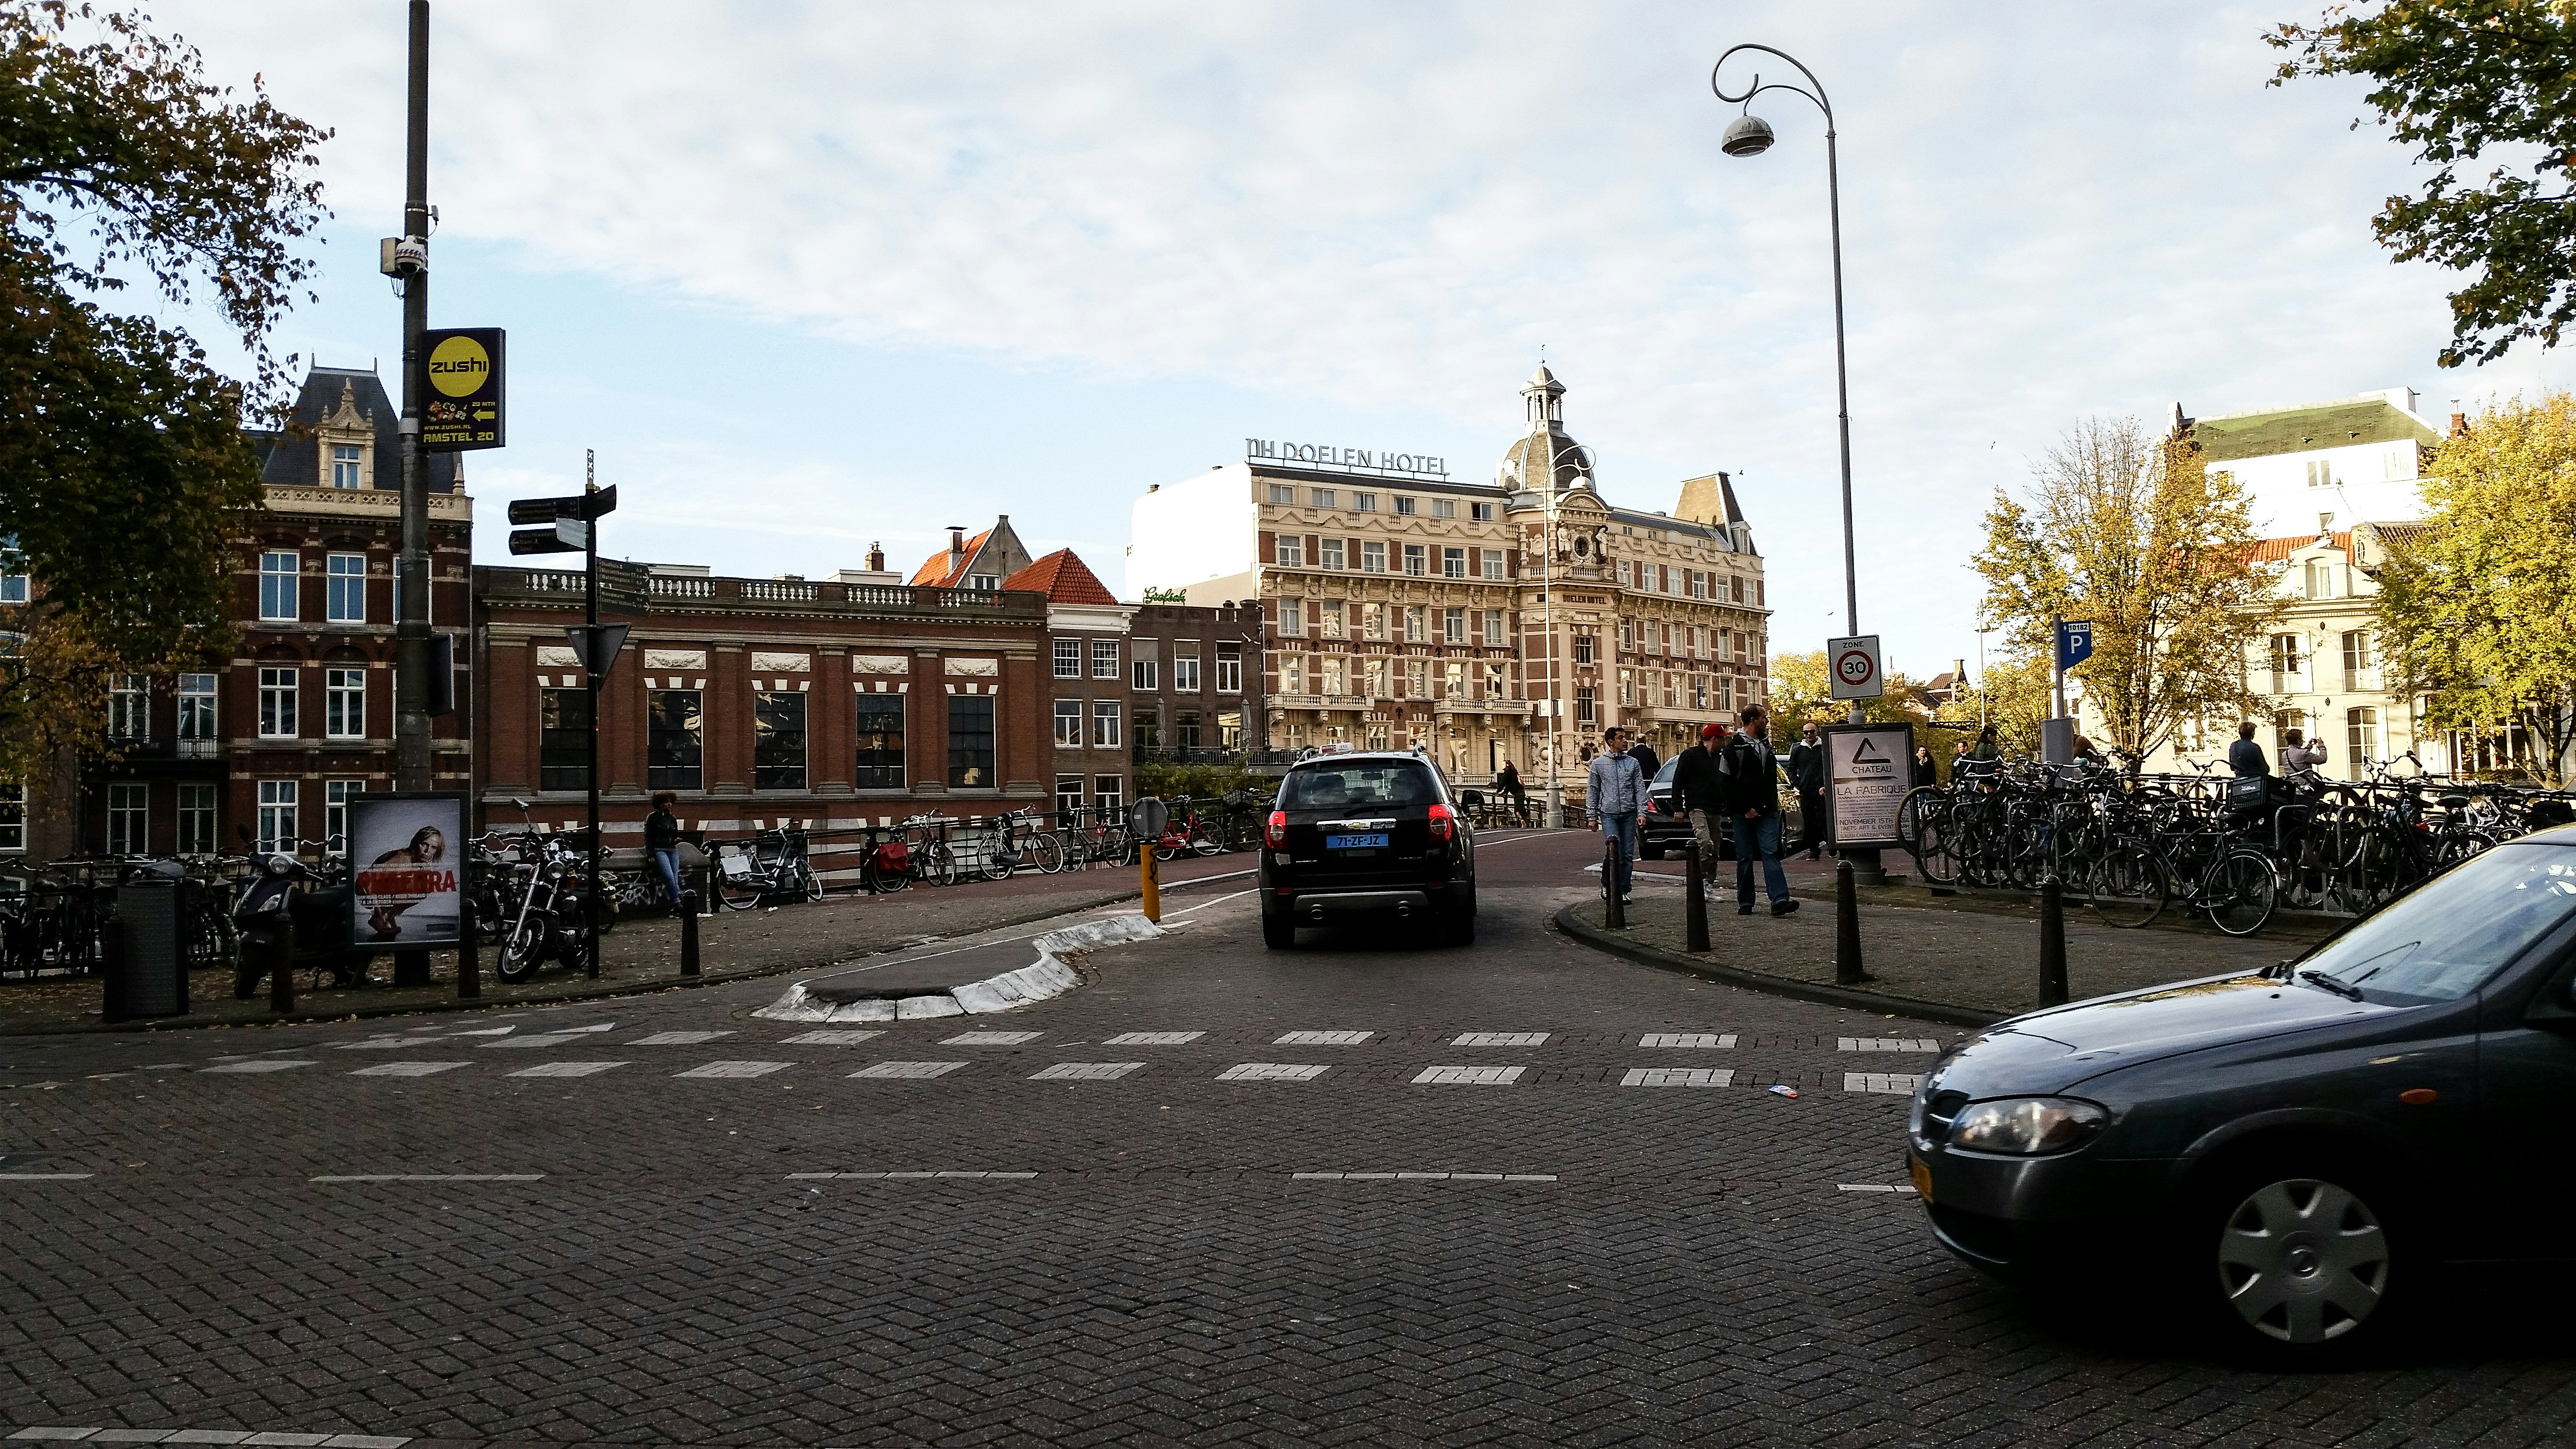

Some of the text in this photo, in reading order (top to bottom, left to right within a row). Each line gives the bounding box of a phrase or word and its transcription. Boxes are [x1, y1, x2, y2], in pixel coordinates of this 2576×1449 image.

[431, 357, 486, 373] zushi
[423, 432, 494, 443] AMSTEL 20
[1283, 442, 1372, 467] DOELEN
[1382, 452, 1450, 476] HOTEL
[1144, 586, 1187, 604] Grolsch
[1562, 595, 1606, 604] DOELEN HOTEL
[2071, 635, 2083, 654] P
[1844, 661, 1867, 675] 30
[1852, 765, 1892, 774] CHATEAU
[1837, 785, 1907, 796] LA FABRIQUE
[1337, 836, 1379, 846] 71-ZF-JZ
